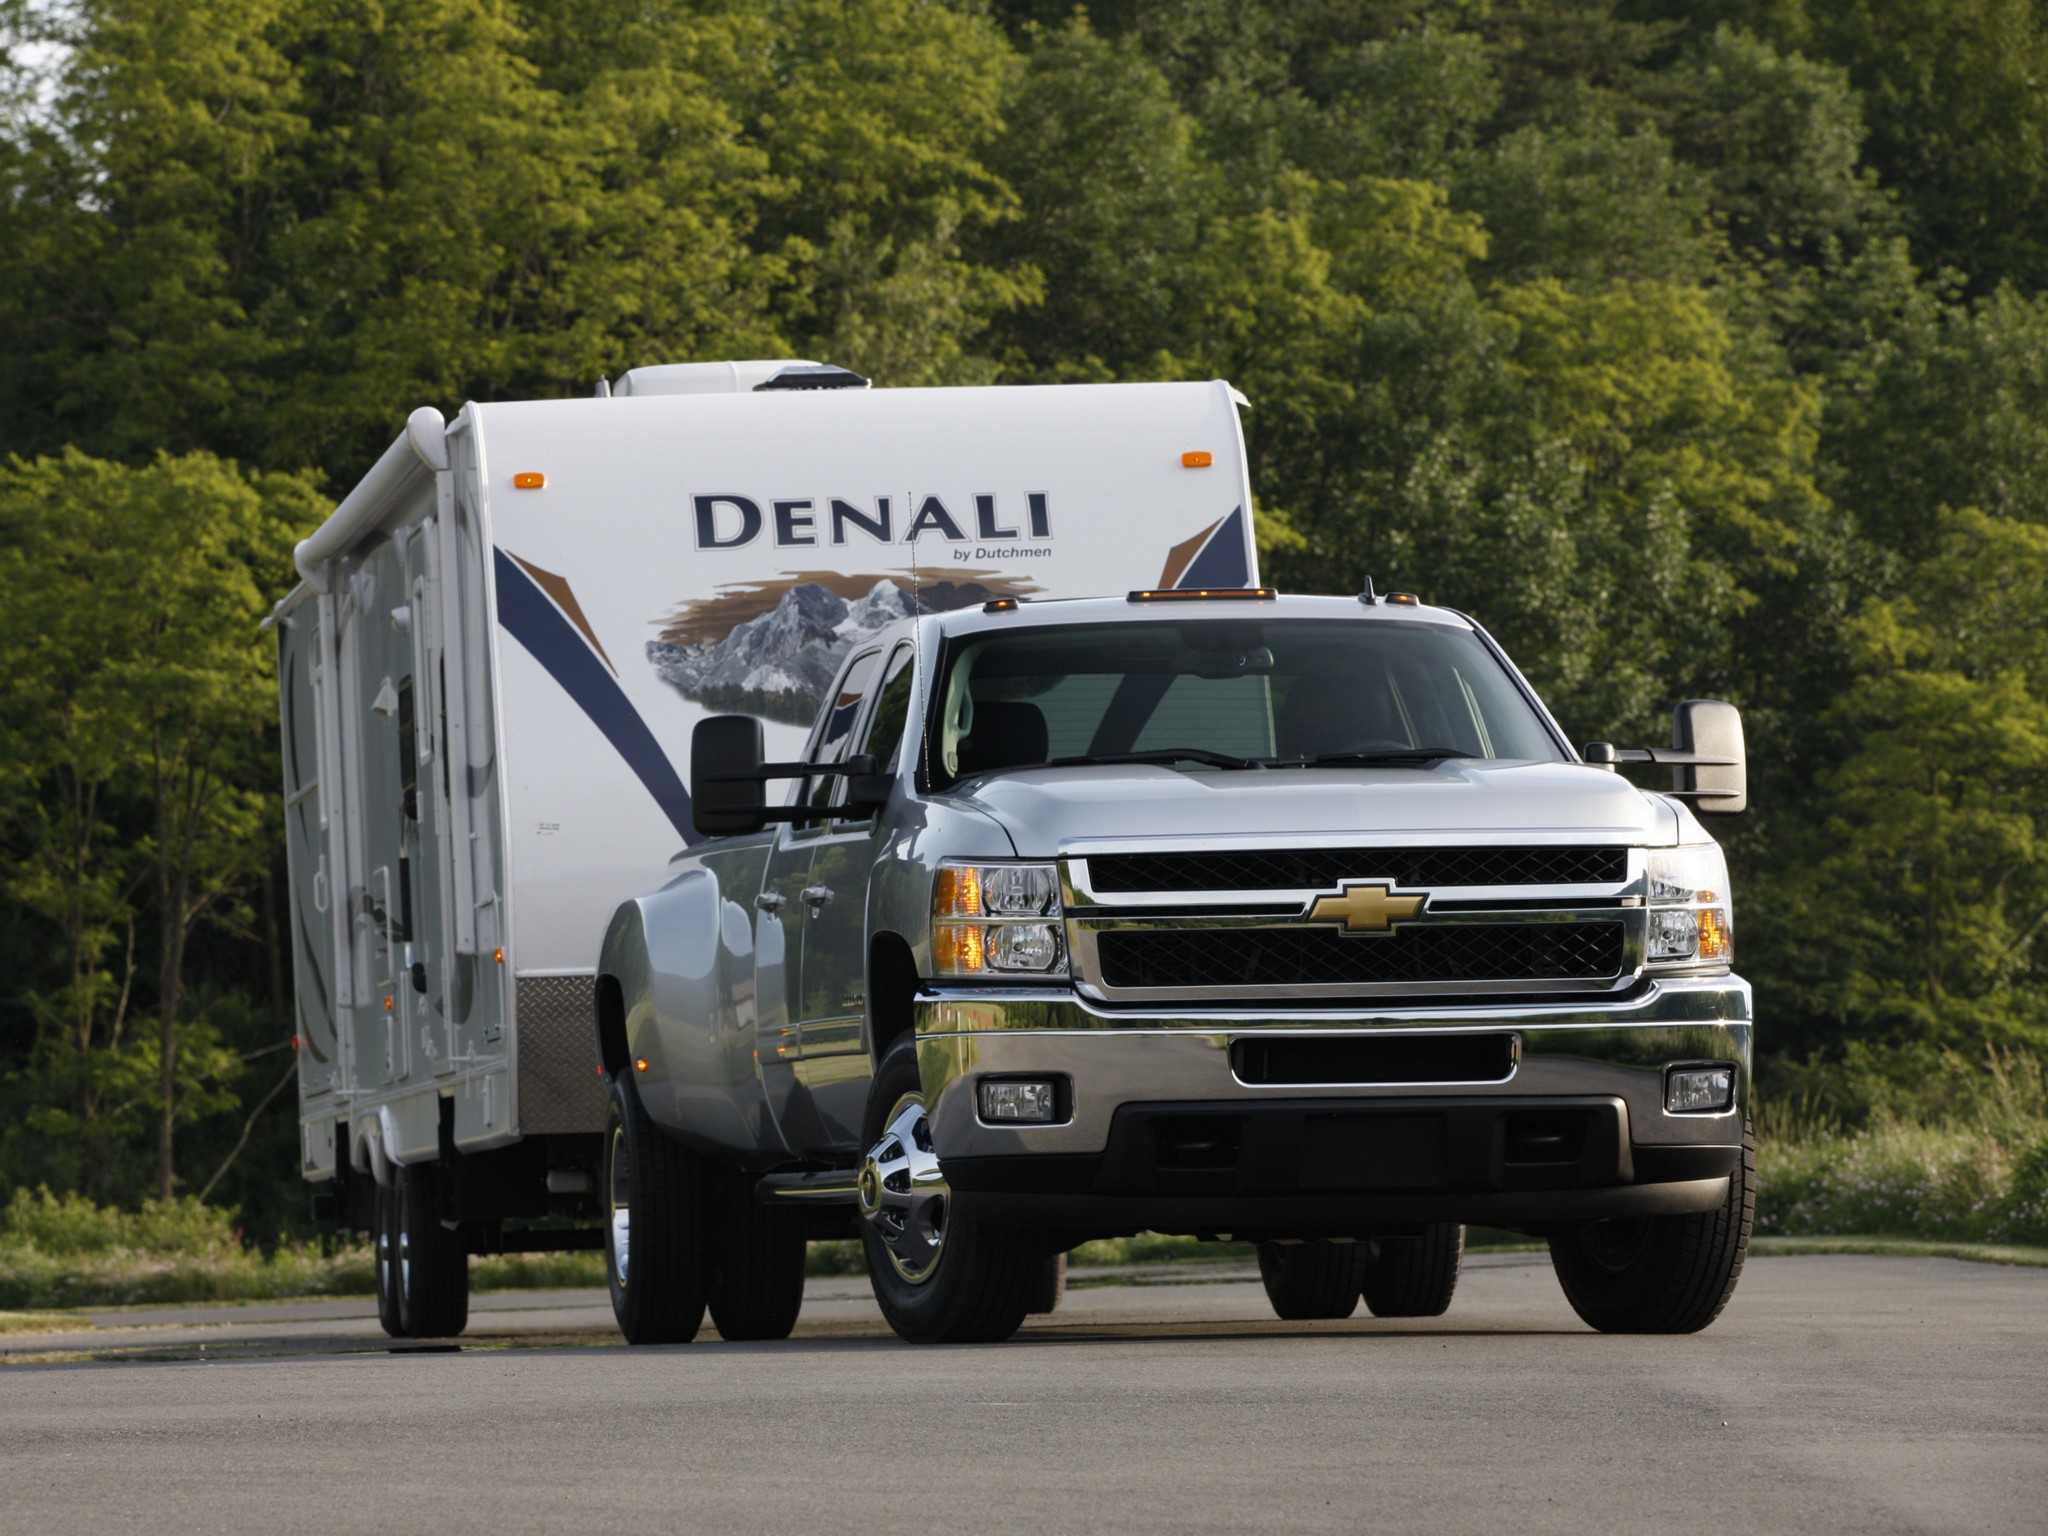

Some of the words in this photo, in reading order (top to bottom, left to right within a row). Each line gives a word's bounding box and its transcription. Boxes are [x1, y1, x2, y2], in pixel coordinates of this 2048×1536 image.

[690, 491, 1053, 551] DENALI
[953, 548, 970, 561] by
[975, 546, 1052, 559] Dutchmen
